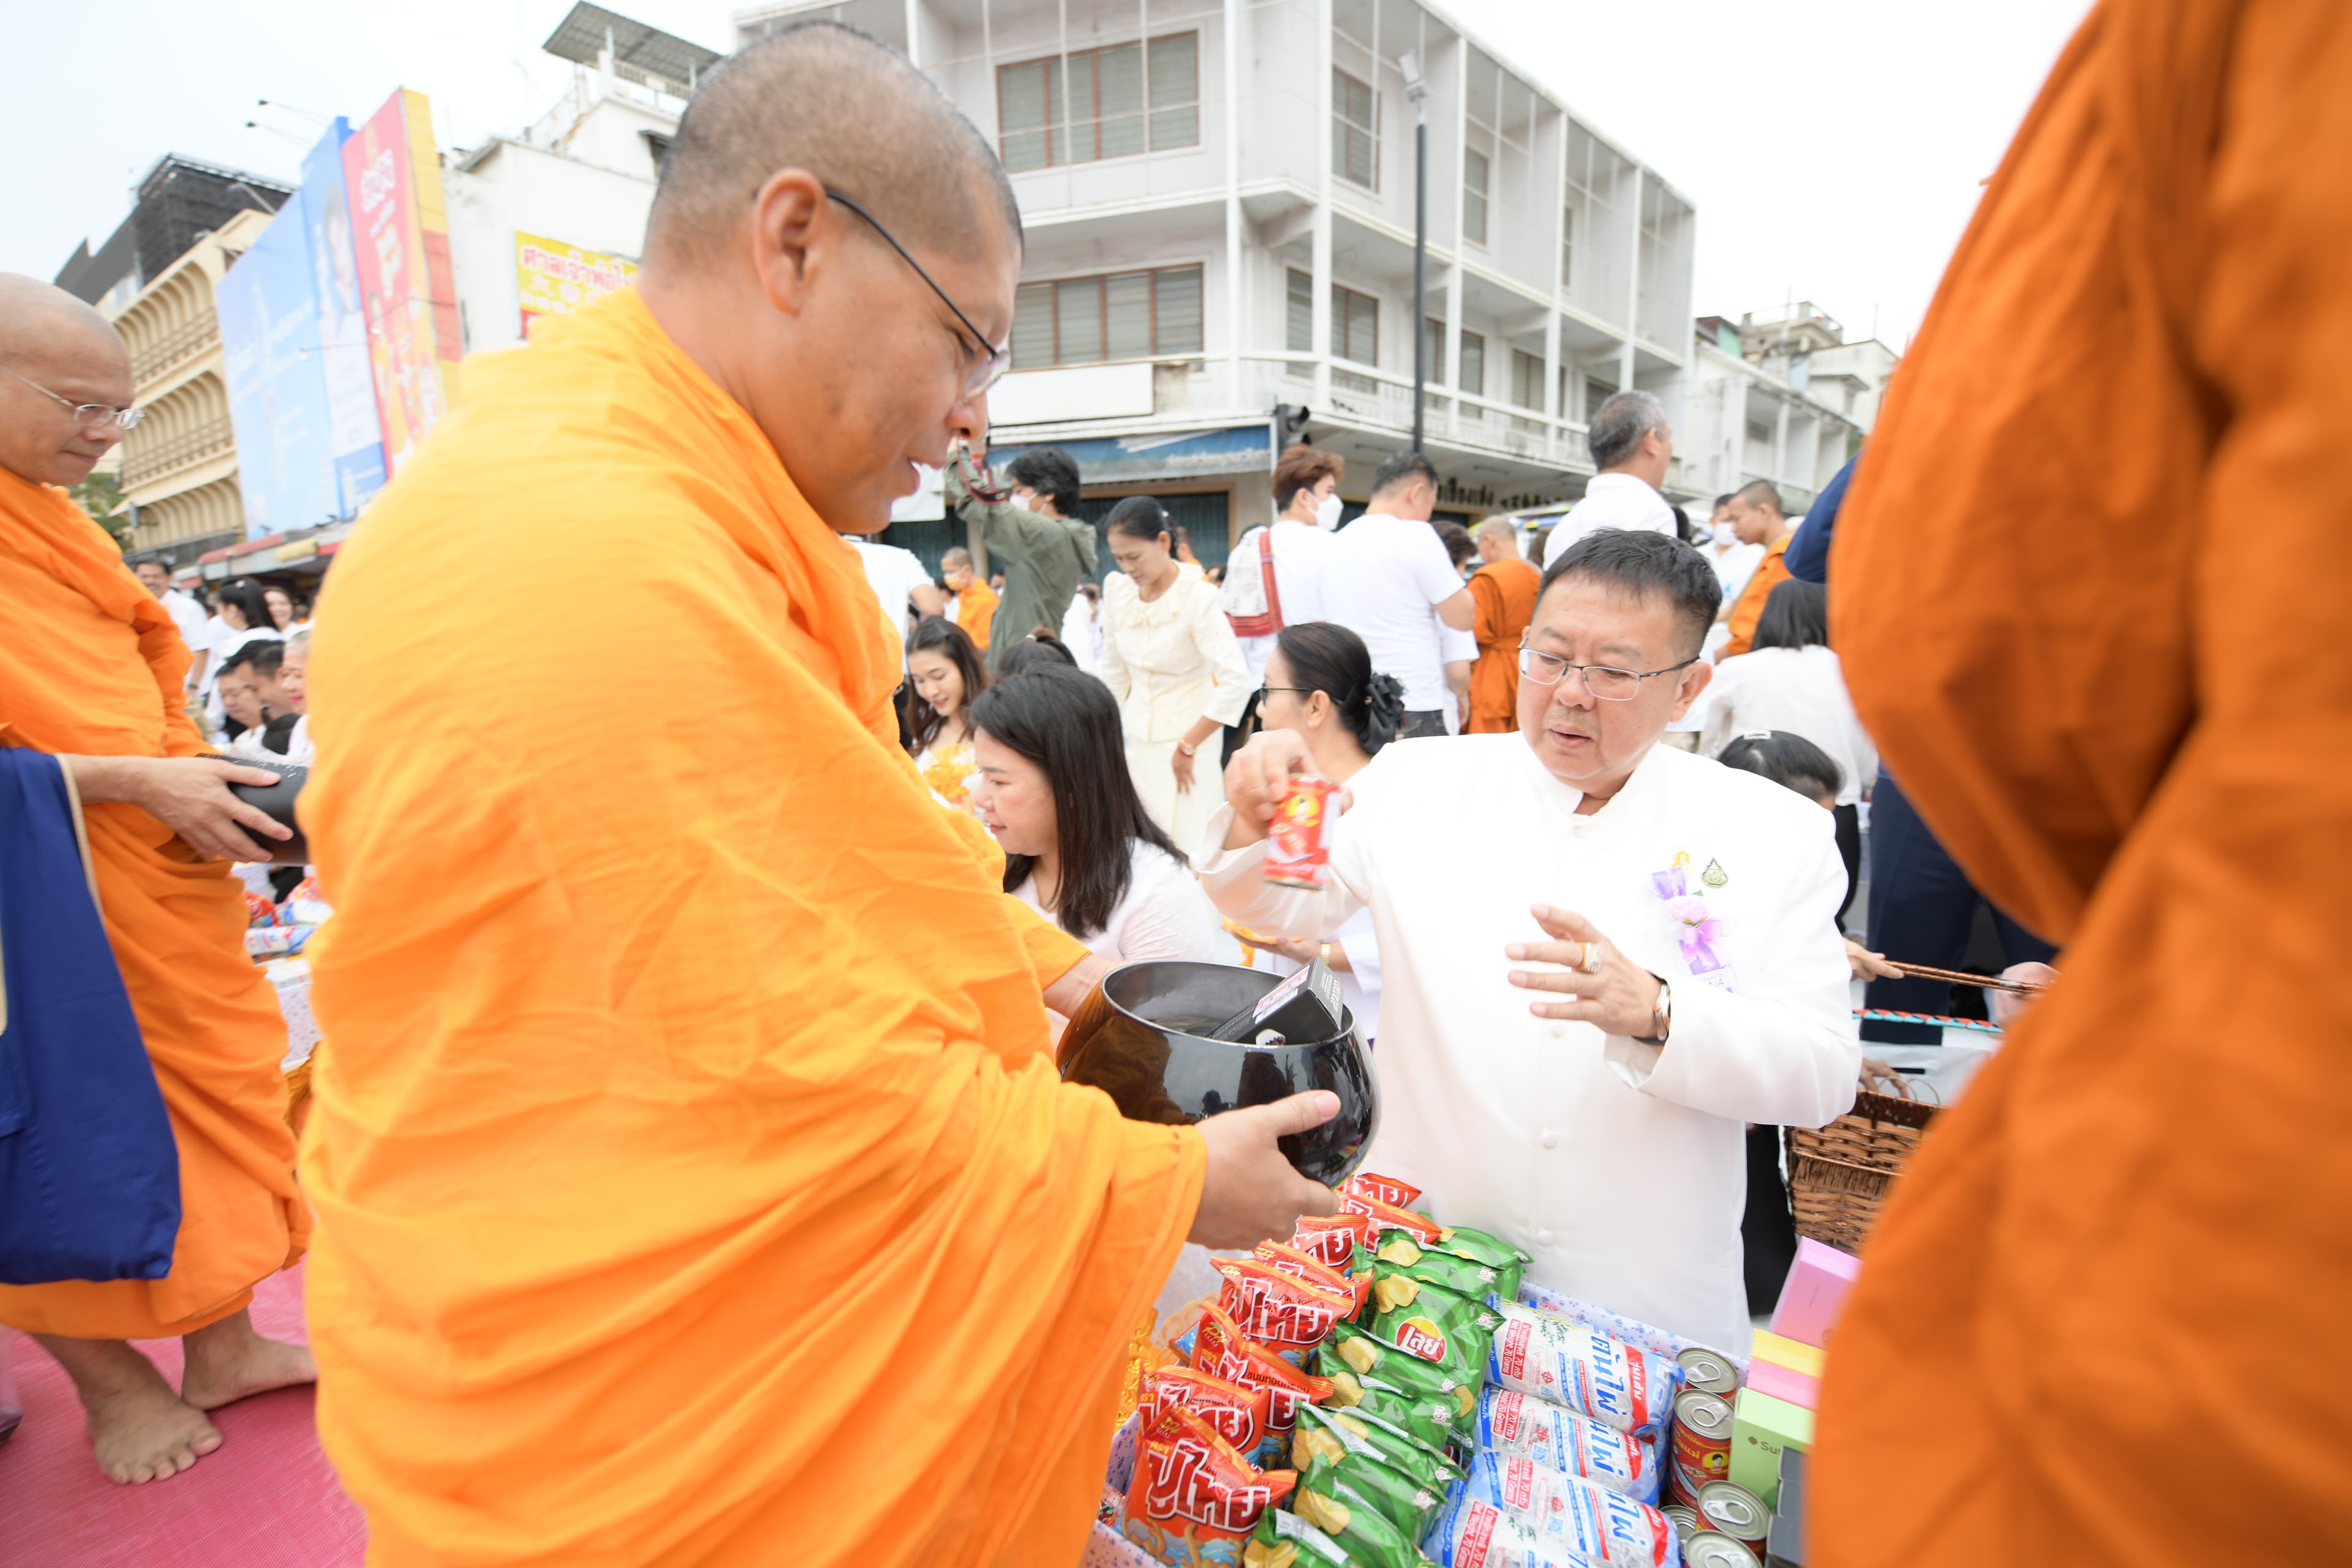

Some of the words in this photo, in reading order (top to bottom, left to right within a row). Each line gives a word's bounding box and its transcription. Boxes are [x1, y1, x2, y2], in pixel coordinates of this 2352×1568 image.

[1502, 1356, 1513, 1373] Grams
[1515, 1357, 1524, 1366] 70
[1494, 1414, 1506, 1433] Grams
[1509, 1413, 1518, 1423] 70
